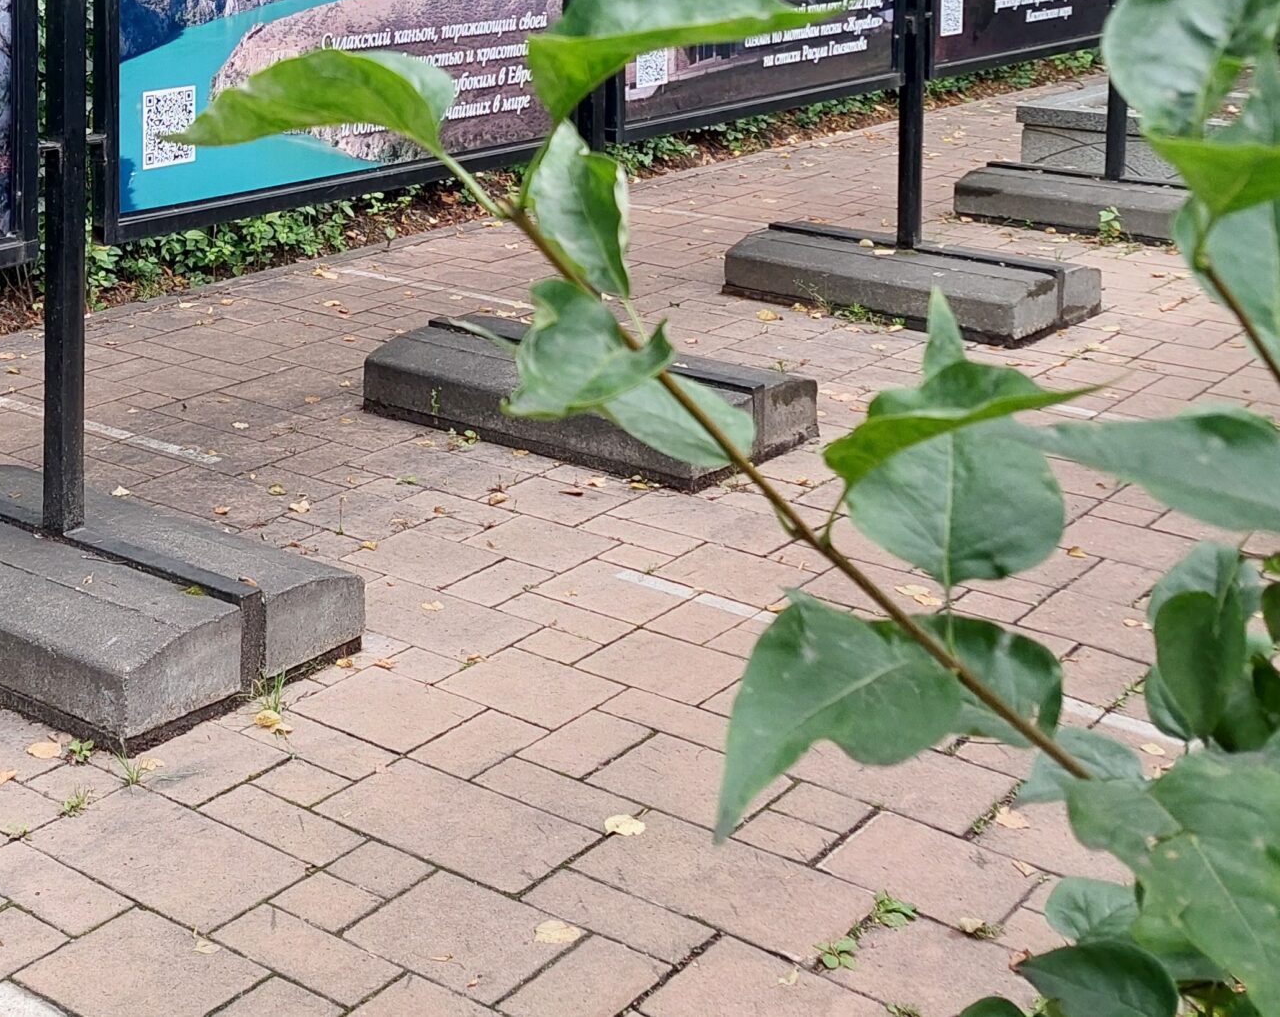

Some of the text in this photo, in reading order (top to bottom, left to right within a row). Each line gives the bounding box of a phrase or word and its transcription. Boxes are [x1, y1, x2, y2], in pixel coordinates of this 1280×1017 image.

[394, 28, 438, 45] каньон,
[441, 15, 517, 43] поражающий
[519, 11, 548, 30] своей
[476, 39, 530, 67] красотой
[497, 66, 507, 86] в
[492, 94, 502, 114] в
[501, 94, 531, 115] мире
